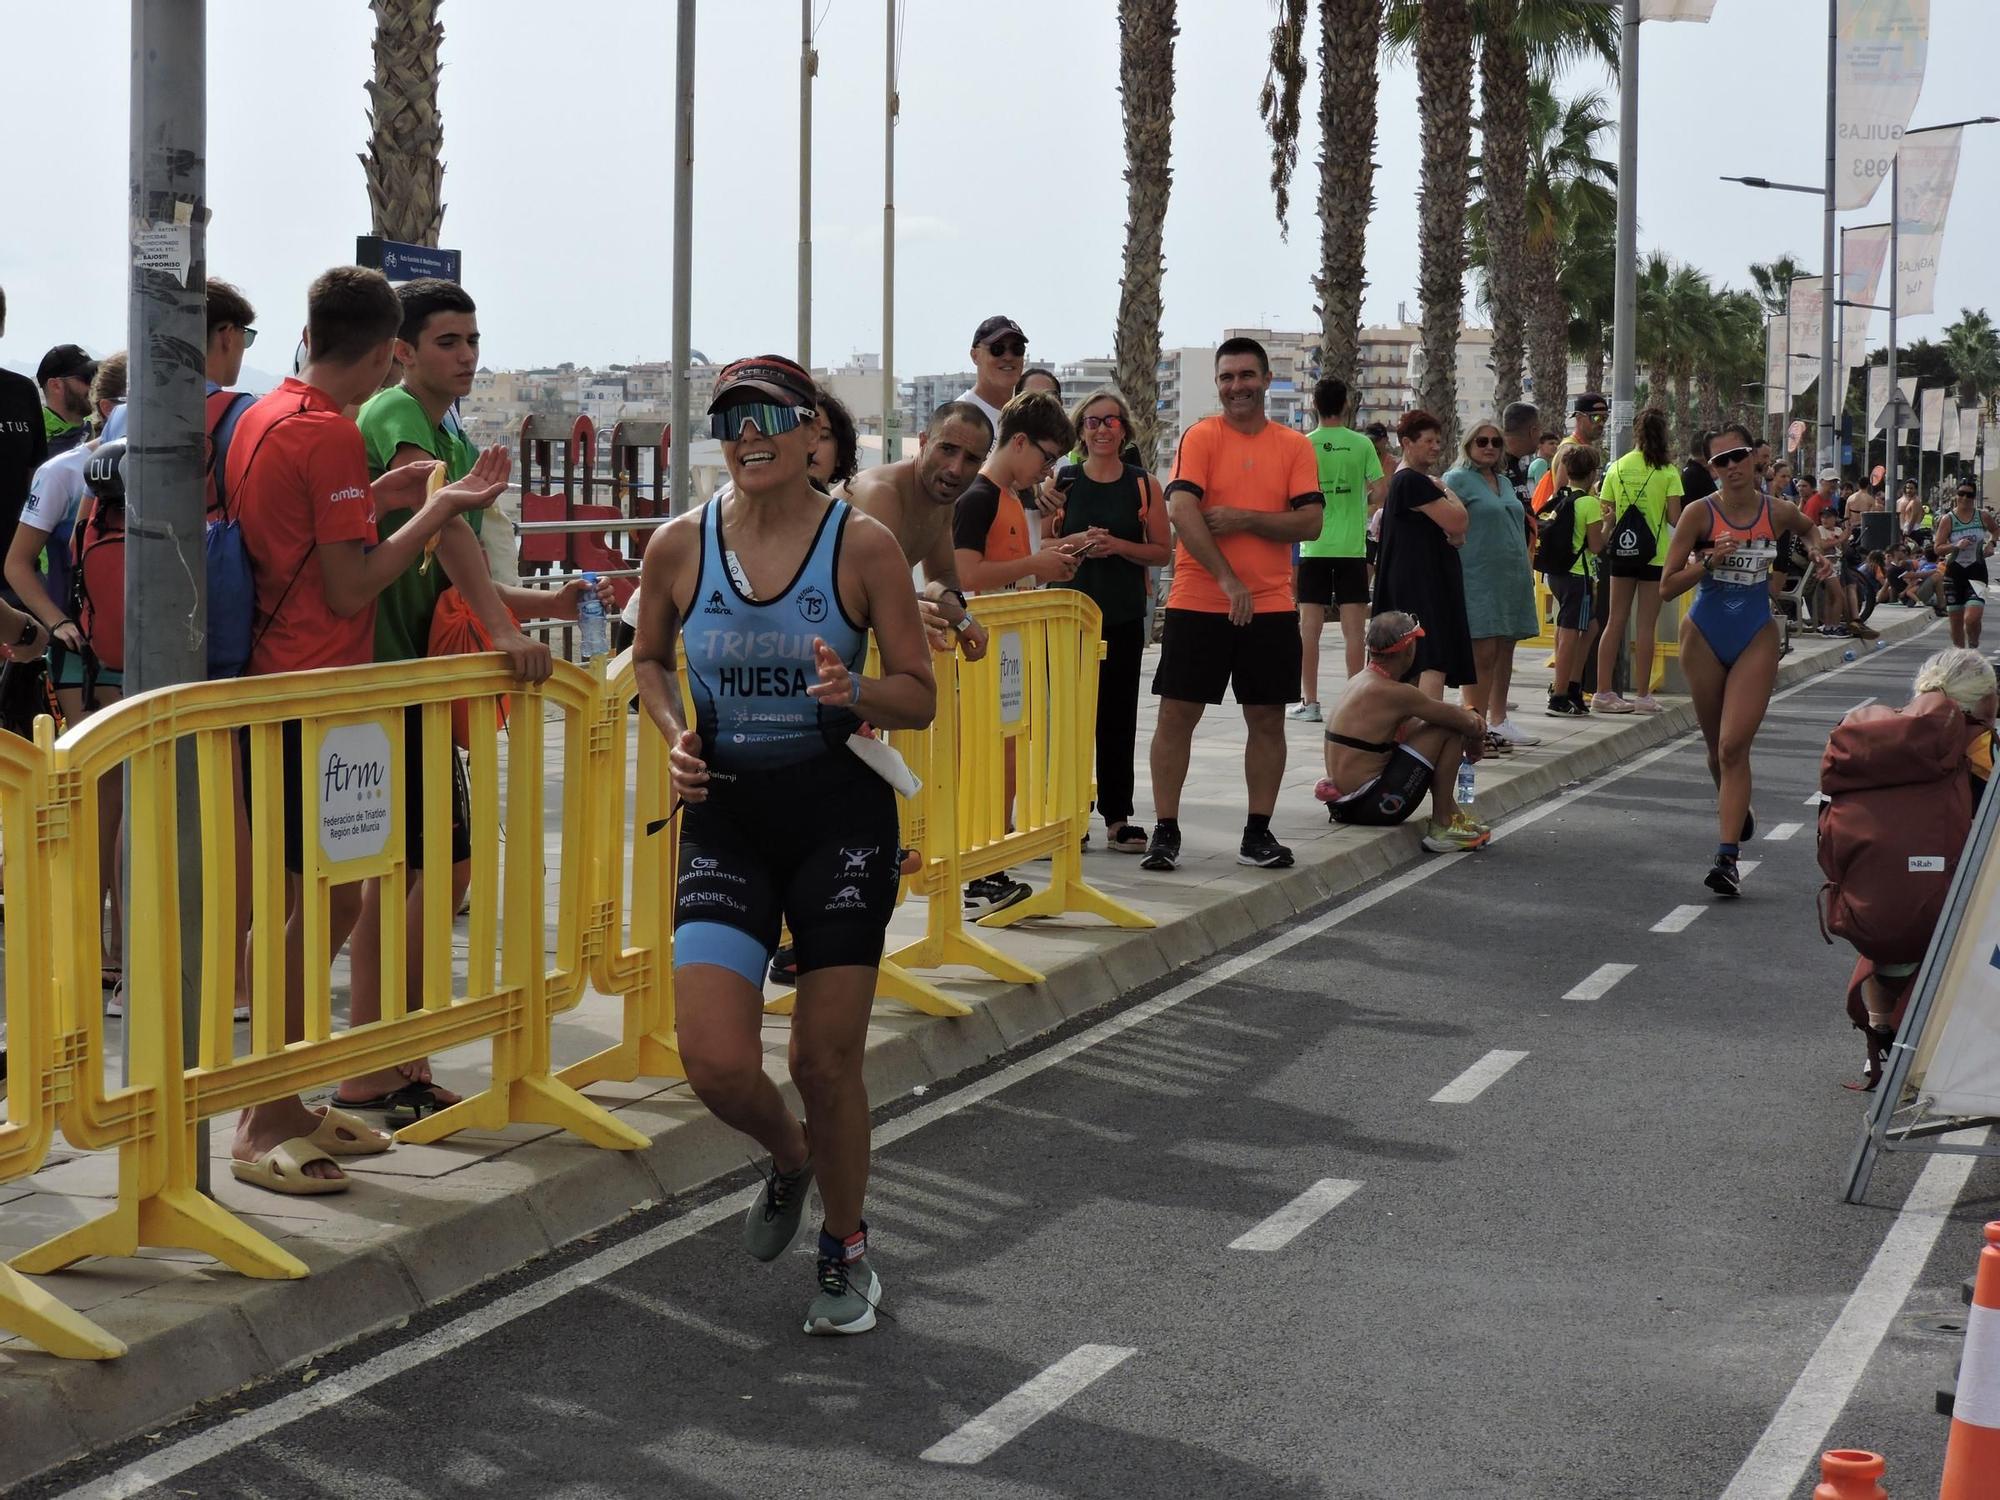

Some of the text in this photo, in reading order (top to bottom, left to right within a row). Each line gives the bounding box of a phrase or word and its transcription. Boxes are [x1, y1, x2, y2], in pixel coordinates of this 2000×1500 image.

[805, 598, 822, 615] TS
[719, 667, 811, 697] HUESA
[325, 752, 385, 802] ftrm
[323, 808, 386, 827] Federación de Triatlón
[330, 822, 380, 839] Región de Murcia
